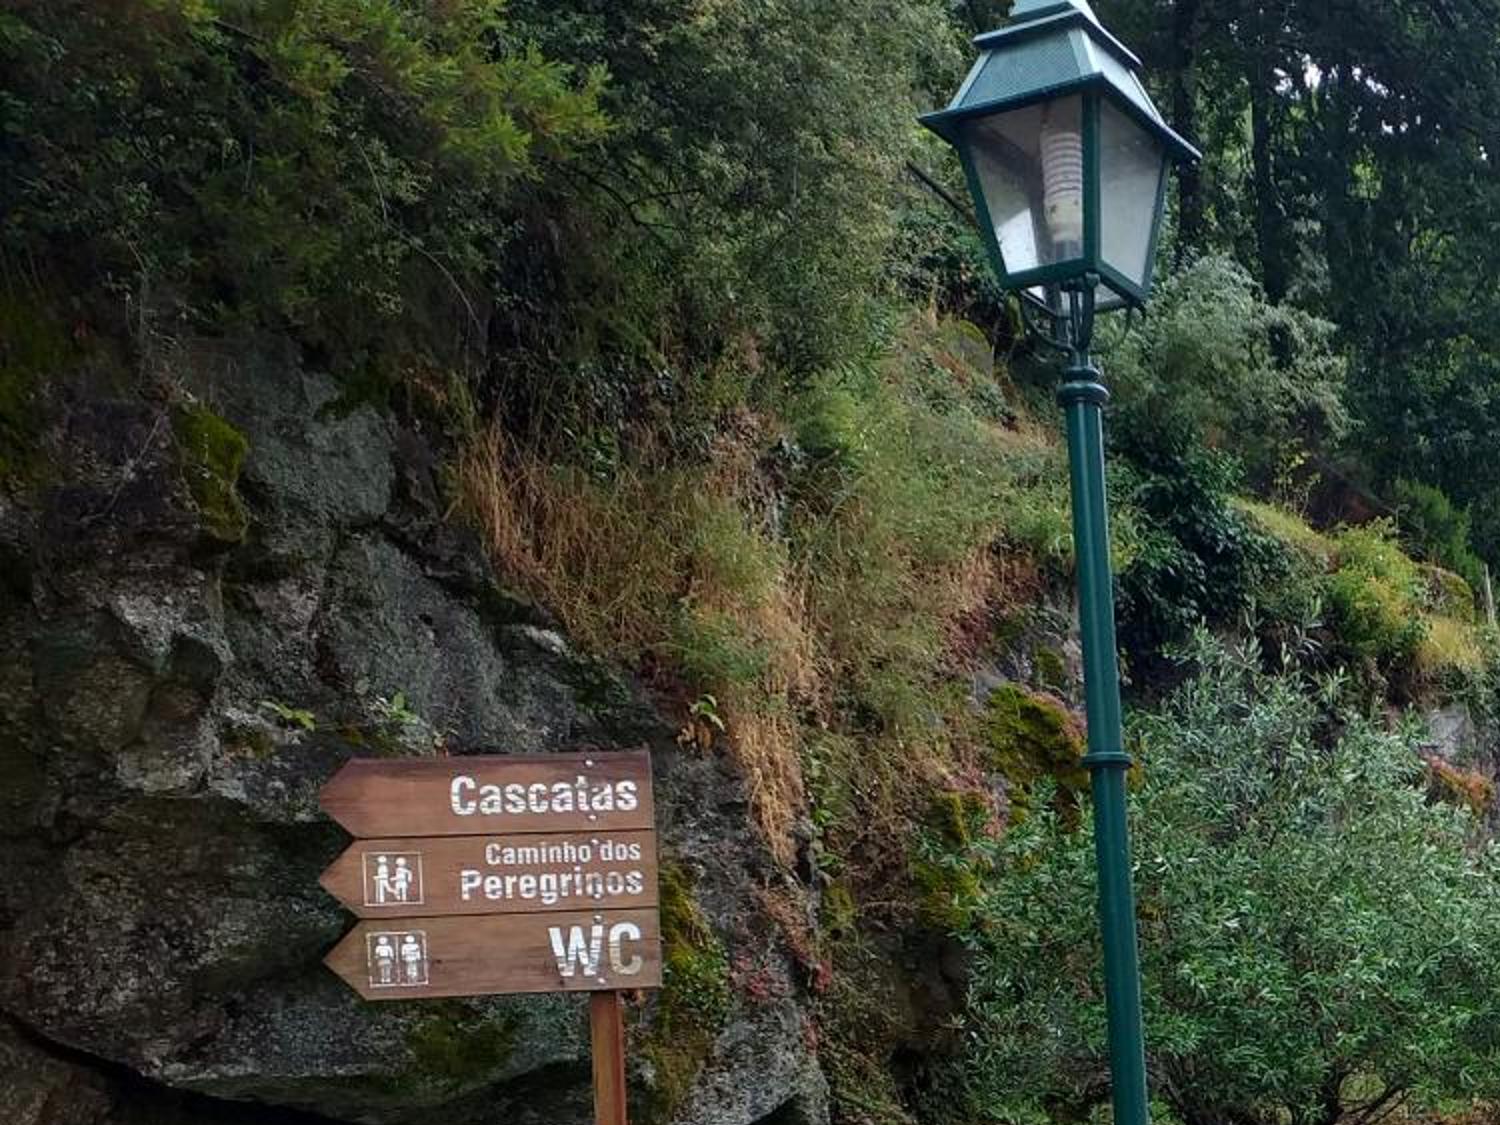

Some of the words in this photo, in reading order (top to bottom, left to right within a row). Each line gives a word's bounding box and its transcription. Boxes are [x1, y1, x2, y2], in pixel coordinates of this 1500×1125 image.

[451, 775, 638, 815] Cascatas
[485, 841, 591, 865] Caminho
[598, 840, 641, 860] dos
[461, 867, 644, 904] Peregrinos
[549, 922, 641, 977] WC
